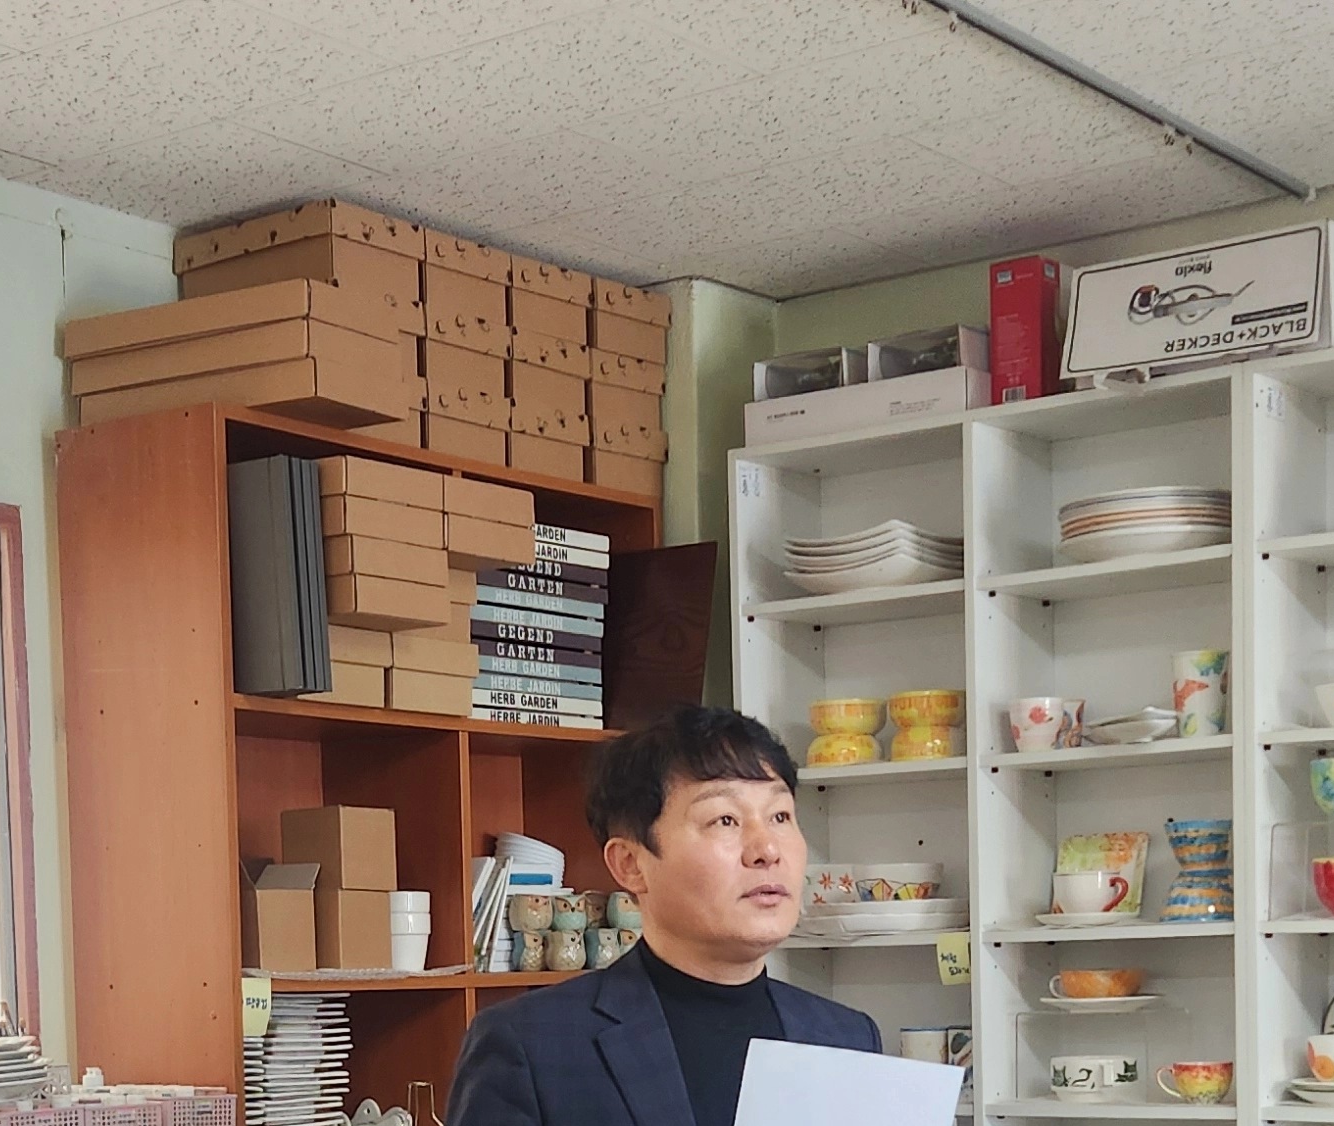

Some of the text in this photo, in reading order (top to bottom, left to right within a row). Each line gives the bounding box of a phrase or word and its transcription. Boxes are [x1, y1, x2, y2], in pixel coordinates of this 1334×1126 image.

[1164, 318, 1307, 353] BLACK+DECKER
[531, 525, 566, 542] ARDEN
[536, 544, 568, 561] JARDIN
[511, 563, 562, 577] EGEND
[508, 573, 564, 595] GARTEN
[495, 589, 524, 604] HERB
[497, 624, 554, 644] GEGEND
[496, 642, 555, 662] GARTEN
[491, 658, 560, 678] HERB GARDEN
[490, 676, 561, 696] HERBE JARDIN
[490, 691, 558, 709] HERB GARDEN
[490, 710, 560, 727] HERBE JARDIN
